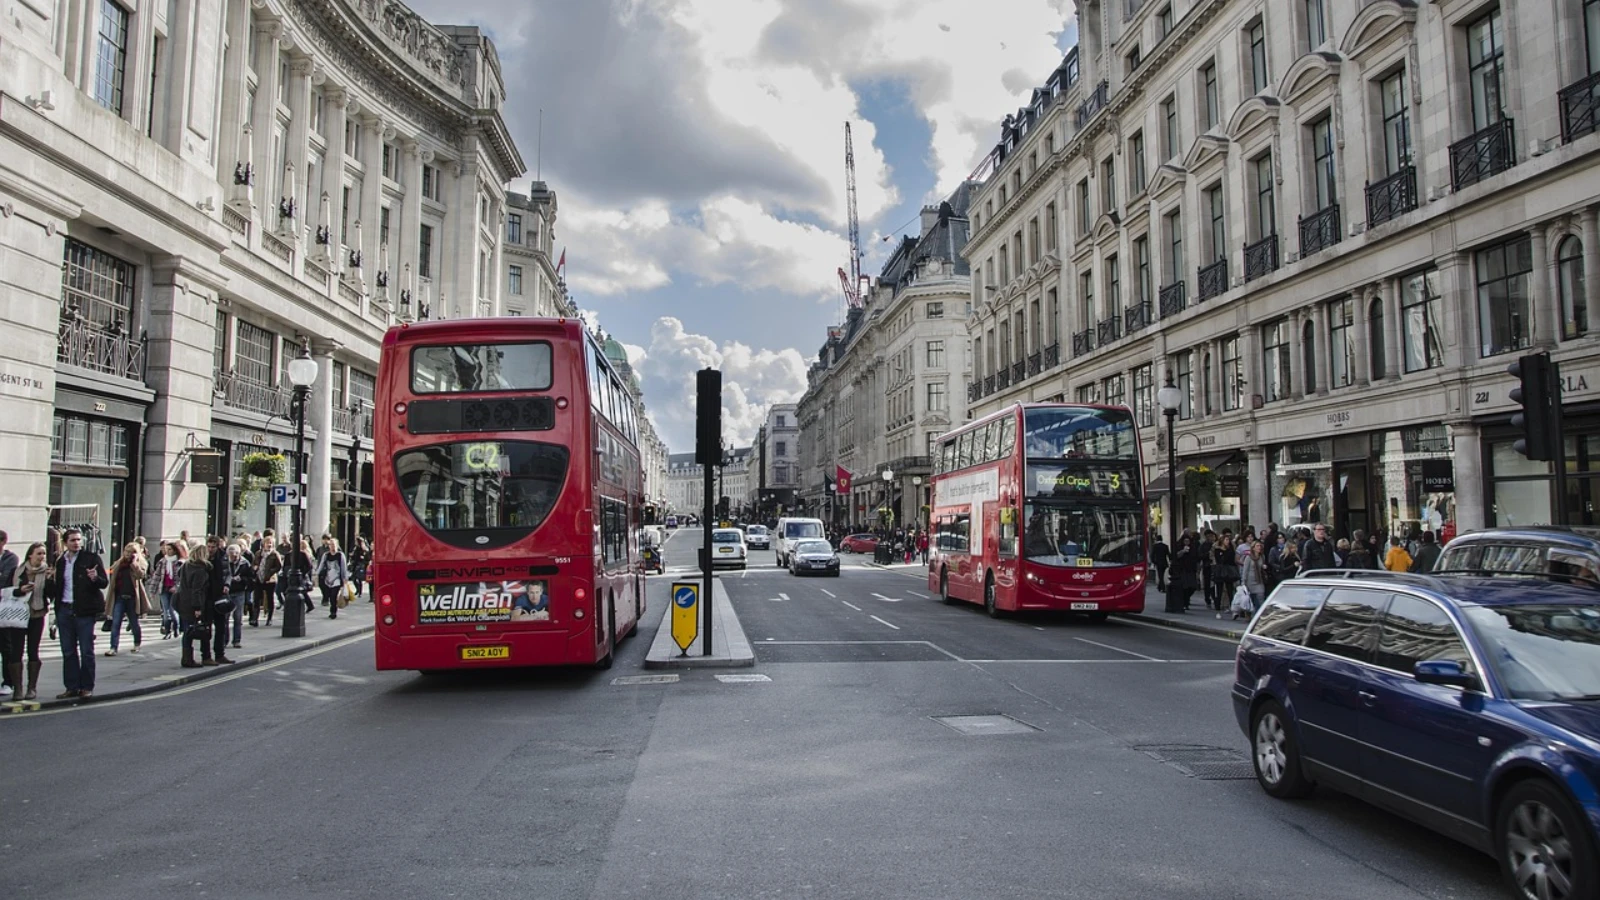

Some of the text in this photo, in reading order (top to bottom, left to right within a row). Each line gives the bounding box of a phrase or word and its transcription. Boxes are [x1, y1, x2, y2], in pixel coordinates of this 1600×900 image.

[0, 373, 21, 386] GENT
[23, 378, 31, 387] ST
[1475, 391, 1490, 404] 221
[1327, 411, 1350, 424] HOBBS
[465, 444, 498, 469] C2
[194, 464, 216, 474] COS
[1037, 475, 1065, 485] Oxford
[1110, 474, 1120, 489] 3
[1425, 477, 1452, 485] HOBBS
[274, 488, 284, 501] P
[437, 566, 505, 578] ENVIRO
[420, 586, 512, 610] wellman
[456, 614, 476, 622] World
[477, 613, 511, 622] Champion
[467, 649, 486, 657] SN12
